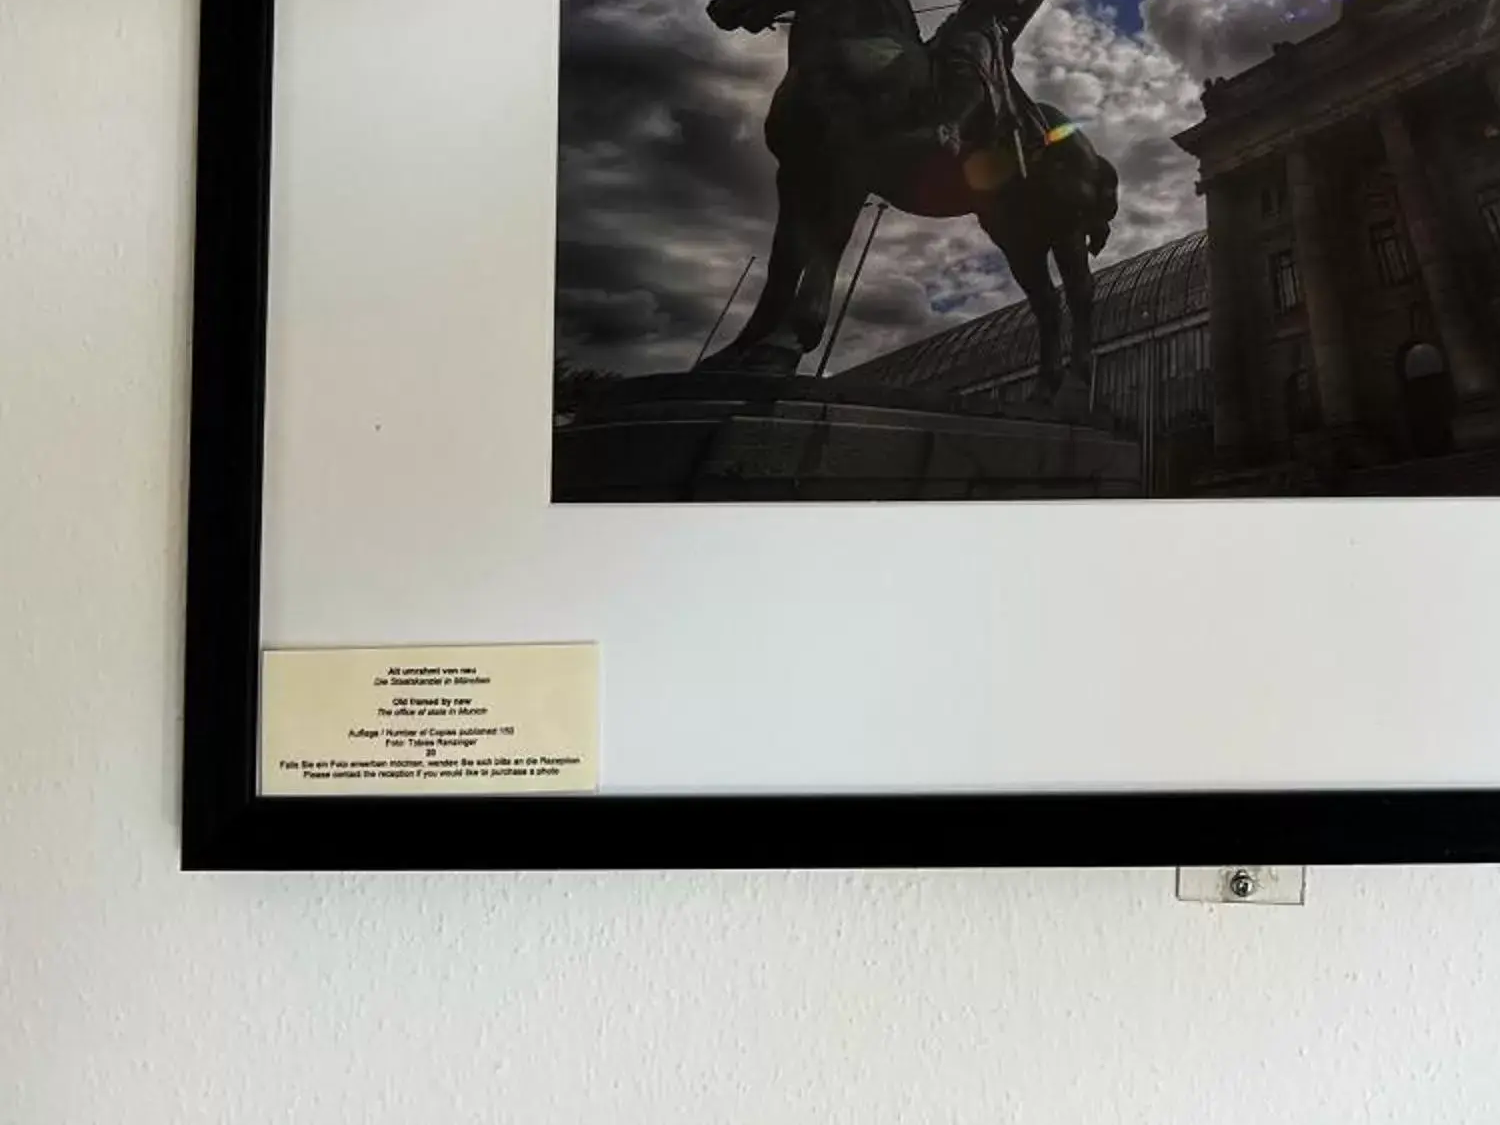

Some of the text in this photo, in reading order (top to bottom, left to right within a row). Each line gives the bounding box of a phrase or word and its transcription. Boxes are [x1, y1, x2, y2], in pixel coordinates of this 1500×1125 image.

[387, 667, 401, 676] Alt
[460, 667, 477, 675] neu
[373, 677, 389, 686] Die
[443, 677, 453, 685] in
[392, 698, 409, 706] Old
[410, 698, 439, 706] framed
[441, 698, 452, 707] by
[378, 708, 393, 716] The
[394, 708, 416, 716] office
[417, 708, 427, 716] of
[427, 708, 447, 716] state
[457, 707, 488, 716] Munich
[348, 727, 379, 739] Auflage
[385, 728, 418, 737] Number
[429, 727, 457, 737] Copies
[459, 726, 497, 736] published
[499, 726, 515, 735] 150
[408, 738, 435, 747] Tobias
[279, 760, 299, 770] Falls
[301, 760, 315, 769] Sie
[315, 761, 329, 770] ein
[461, 757, 475, 766] Sie
[476, 757, 492, 766] sich
[525, 757, 538, 765] die
[303, 770, 331, 779] Please
[331, 770, 361, 779] contact
[362, 770, 376, 778] the
[377, 770, 415, 778] reception
[423, 770, 439, 779] you
[439, 768, 463, 777] would
[465, 768, 479, 776] like
[480, 768, 489, 776] to
[490, 768, 528, 778] purchase
